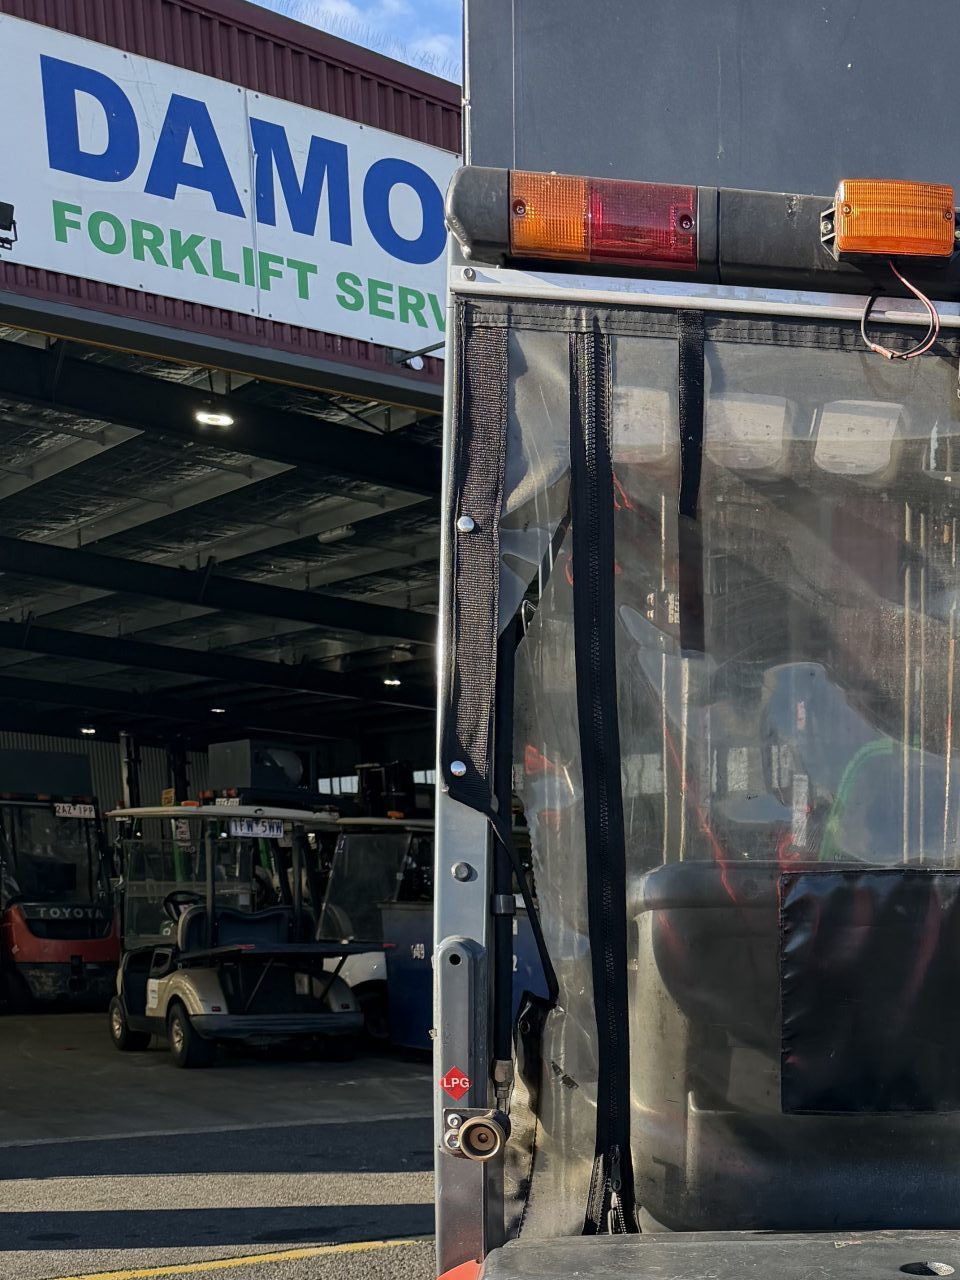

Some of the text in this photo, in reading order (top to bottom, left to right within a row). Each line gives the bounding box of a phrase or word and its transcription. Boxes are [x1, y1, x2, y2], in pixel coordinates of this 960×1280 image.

[40, 54, 447, 265] DAMO
[52, 200, 446, 332] FORKLIFT SERV
[36, 907, 105, 918] TOYOTA
[443, 1077, 470, 1088] LPG
